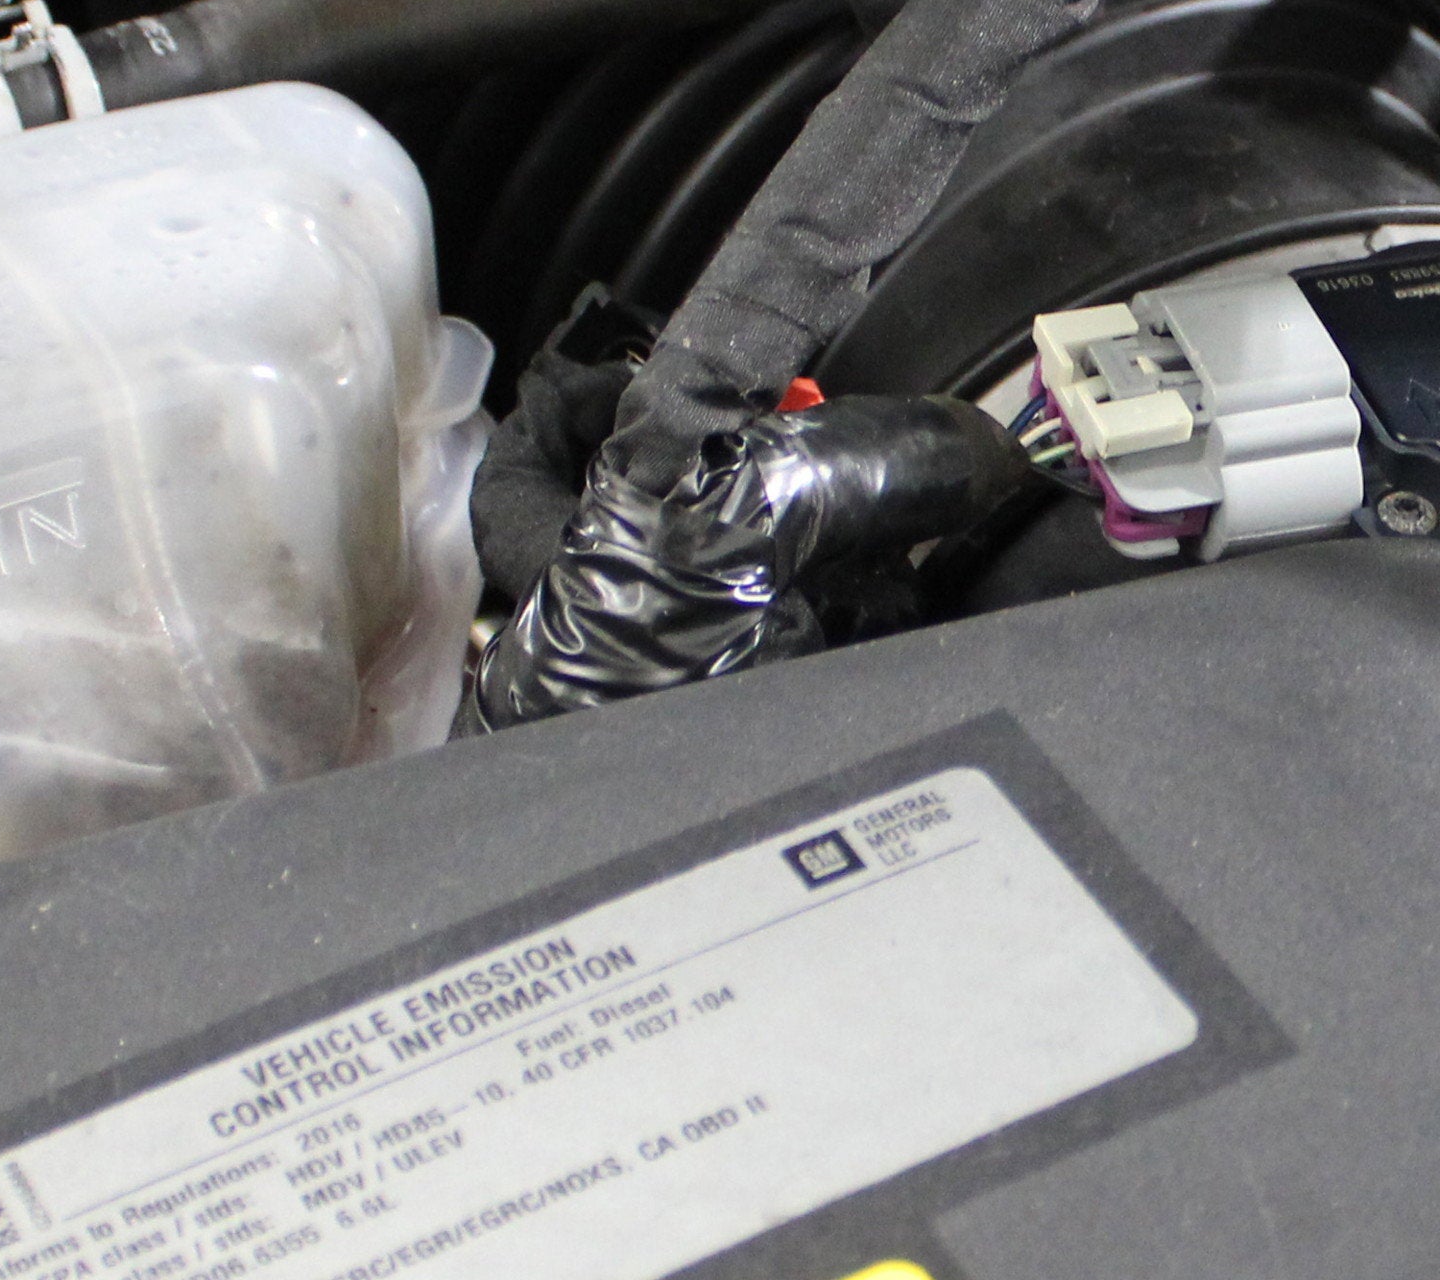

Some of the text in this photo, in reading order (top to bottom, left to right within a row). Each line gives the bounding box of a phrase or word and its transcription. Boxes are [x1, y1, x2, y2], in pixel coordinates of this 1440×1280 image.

[850, 787, 946, 835] GENERAL
[863, 804, 953, 851] MOTORS
[876, 840, 919, 867] LLC
[204, 942, 640, 1139] CONTROL INFORMATION
[239, 935, 580, 1090] VEHICLE EMISSION
[513, 980, 675, 1059] Fuel: Diesel
[96, 1225, 168, 1269] class
[283, 1148, 350, 1189] HDV
[517, 1060, 556, 1088] 40
[556, 1035, 616, 1071] CFR
[298, 1170, 370, 1214] MDV
[390, 1128, 468, 1173] ULEV
[634, 1131, 679, 1163] CA
[677, 1104, 743, 1145] OBD
[85, 1217, 115, 1242] to
[118, 1146, 284, 1231] Regulations:
[293, 1111, 364, 1153] 2016
[331, 1189, 400, 1232] 6.6L
